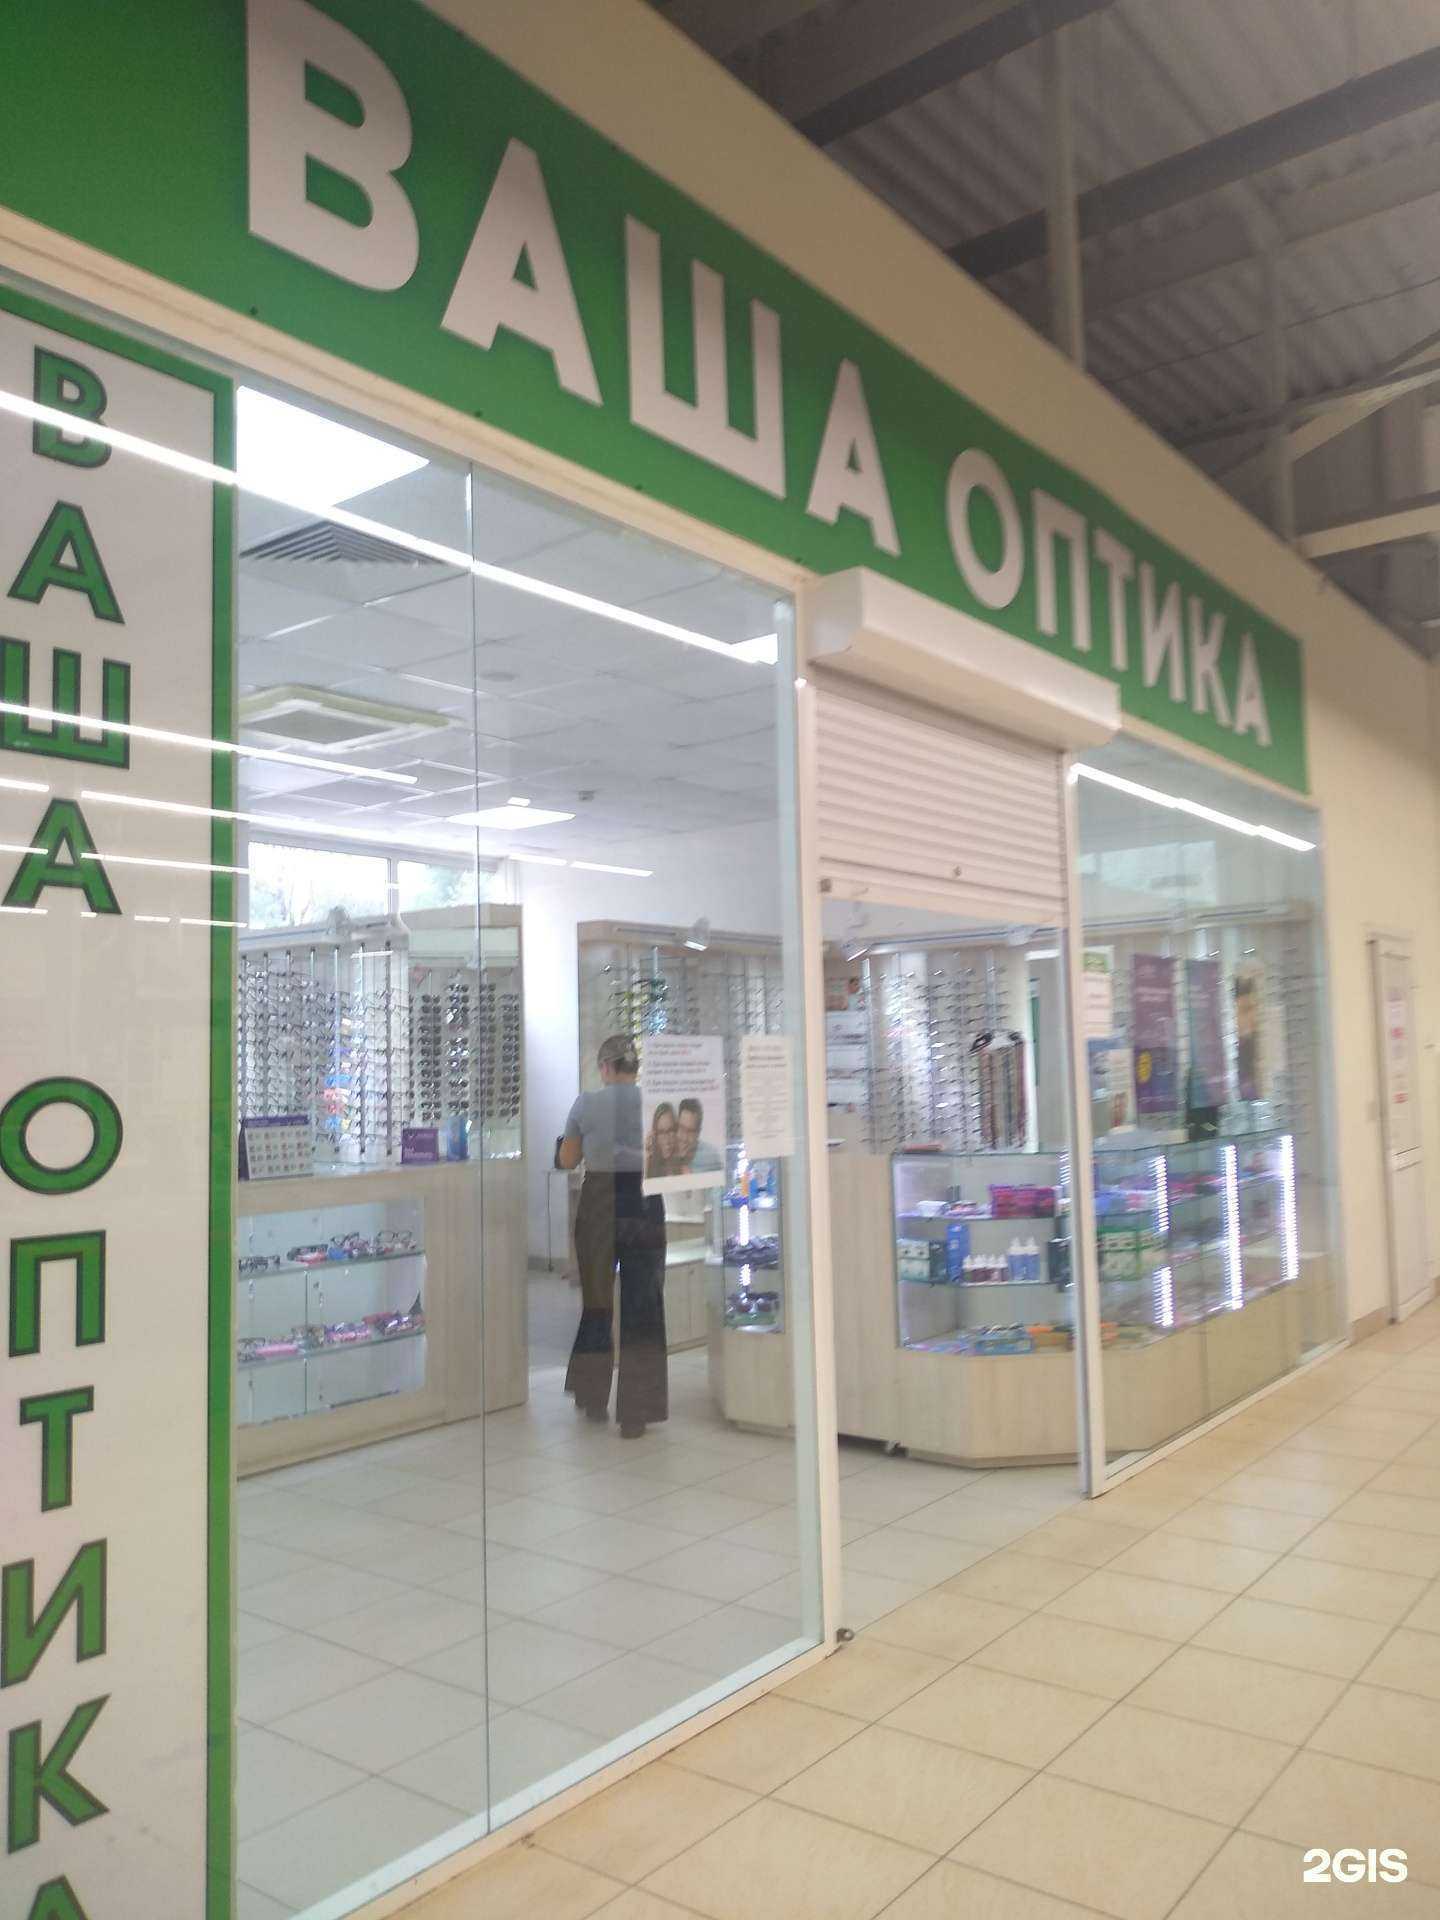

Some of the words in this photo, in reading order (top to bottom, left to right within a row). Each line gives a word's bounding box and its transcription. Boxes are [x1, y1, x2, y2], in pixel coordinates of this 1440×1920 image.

[0, 344, 131, 915] ВАША
[246, 0, 901, 558] ВАША
[946, 447, 1272, 747] ОПТИКА
